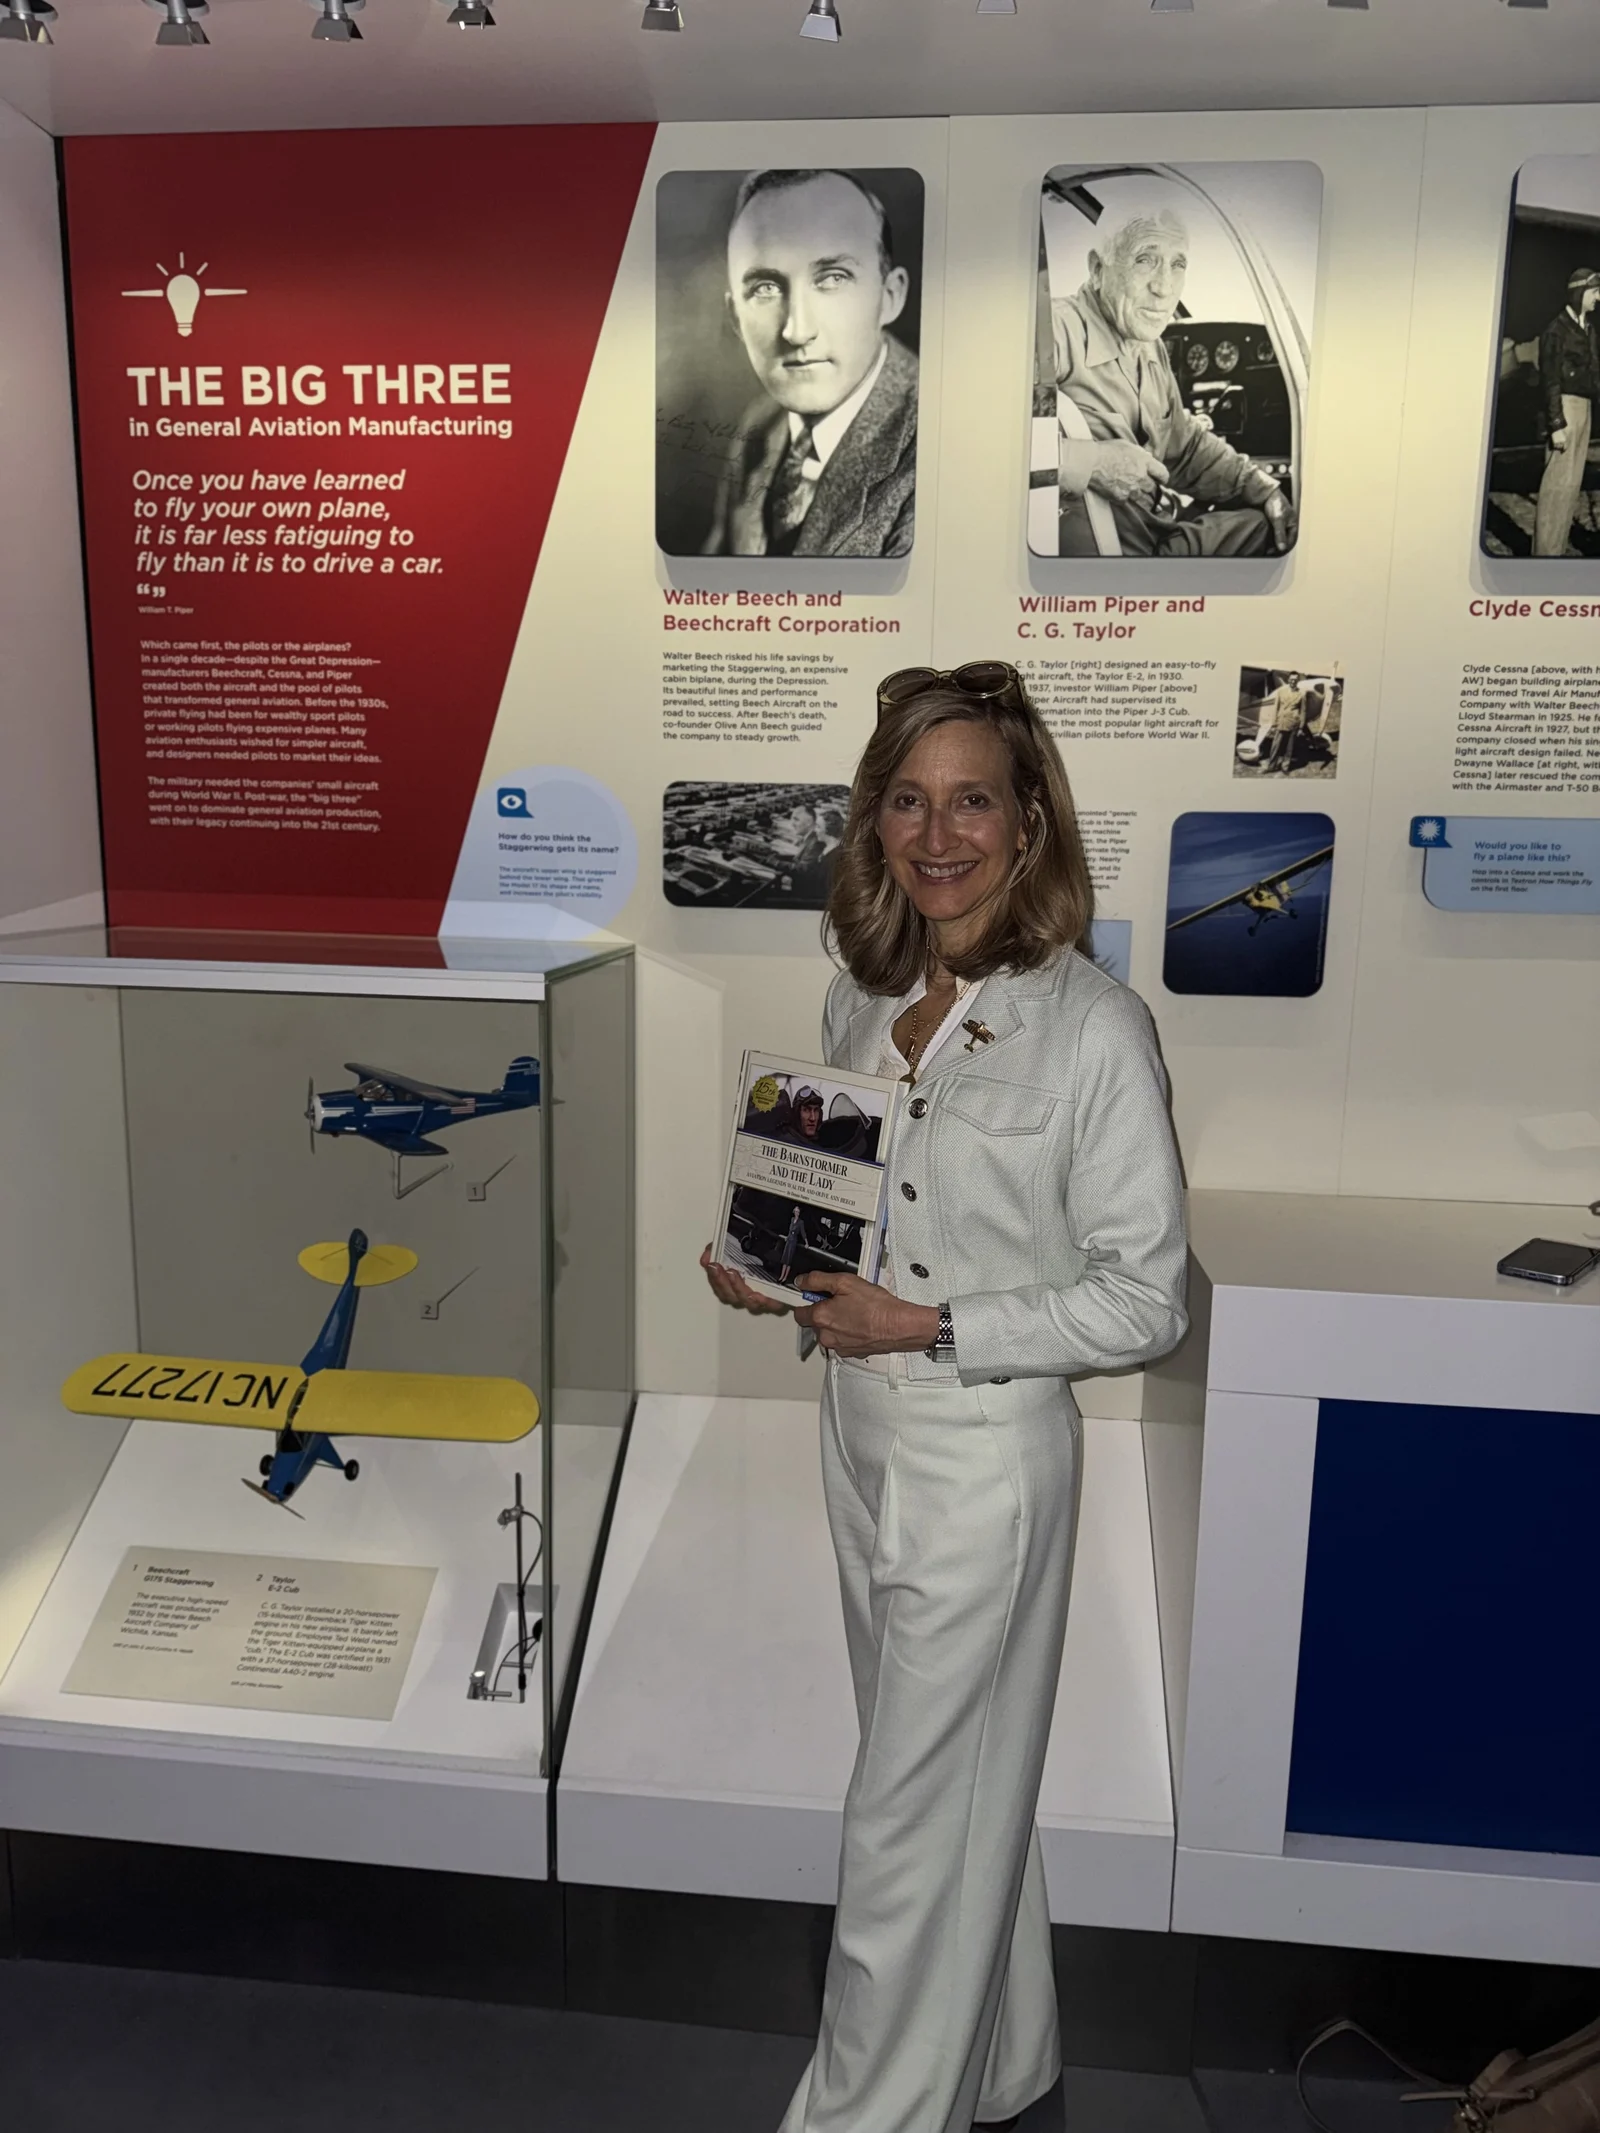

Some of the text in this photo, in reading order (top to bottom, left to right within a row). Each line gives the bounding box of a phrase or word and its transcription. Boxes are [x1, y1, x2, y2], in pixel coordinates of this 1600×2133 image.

[126, 363, 512, 406] THE BIG THREE
[129, 415, 513, 439] in General Aviation Manufacturing
[132, 468, 407, 494] Once you have learned
[134, 496, 390, 525] to fly your own plane,
[135, 524, 414, 550] it is far less fatiguing to
[137, 551, 443, 576] fly than it is to drive a car.
[663, 588, 842, 607] Walter Beech and
[138, 606, 166, 614] William
[174, 606, 194, 614] Piper
[1018, 595, 1205, 616] William Piper and
[1469, 599, 1600, 620] Clyde Cessn
[663, 614, 900, 636] Beechcraft Corporation
[1017, 622, 1136, 642] C. G. Taylor
[140, 640, 352, 652] Which came first, the pilots or the airplanes?
[141, 654, 381, 667] In a single decade—despite the Great Depression—
[662, 652, 834, 663] Walter Beech risked his life savings by
[662, 663, 708, 674] marketing
[710, 664, 725, 672] the
[727, 664, 787, 675] Staggerwing,
[803, 666, 849, 675] expensive
[1015, 660, 1024, 669] C.
[1027, 660, 1036, 669] G.
[1040, 660, 1068, 670] Taylor
[1070, 660, 1102, 670] [right]
[1104, 660, 1149, 670] designed
[1165, 660, 1217, 670] easy-to-fly
[1462, 664, 1593, 675] Clyde Cessna [above, with
[662, 675, 829, 686] cabin biplane, during the Depression.
[1038, 672, 1074, 681] aircraft,
[1076, 672, 1092, 680] the
[1095, 672, 1124, 682] Taylor
[1126, 672, 1145, 681] E-2,
[1159, 672, 1183, 681] 1930.
[1462, 676, 1484, 686] AW]
[1486, 676, 1518, 687] began
[1520, 677, 1561, 687] building
[662, 686, 818, 697] Its beautiful lines and performance
[498, 832, 591, 843] How do you think the
[498, 842, 619, 854] Staggerwing gets its name?
[1474, 841, 1562, 852] Would you like to
[1473, 852, 1486, 862] fly
[1497, 853, 1525, 862] plane
[1527, 853, 1545, 862] like
[1547, 854, 1571, 862] this?
[762, 1144, 848, 1177] THE BARNSTORMER
[770, 1164, 836, 1191] AND THE LADY
[472, 1187, 478, 1196] 1
[424, 1305, 432, 1314] 2
[92, 1364, 288, 1409] NC17277
